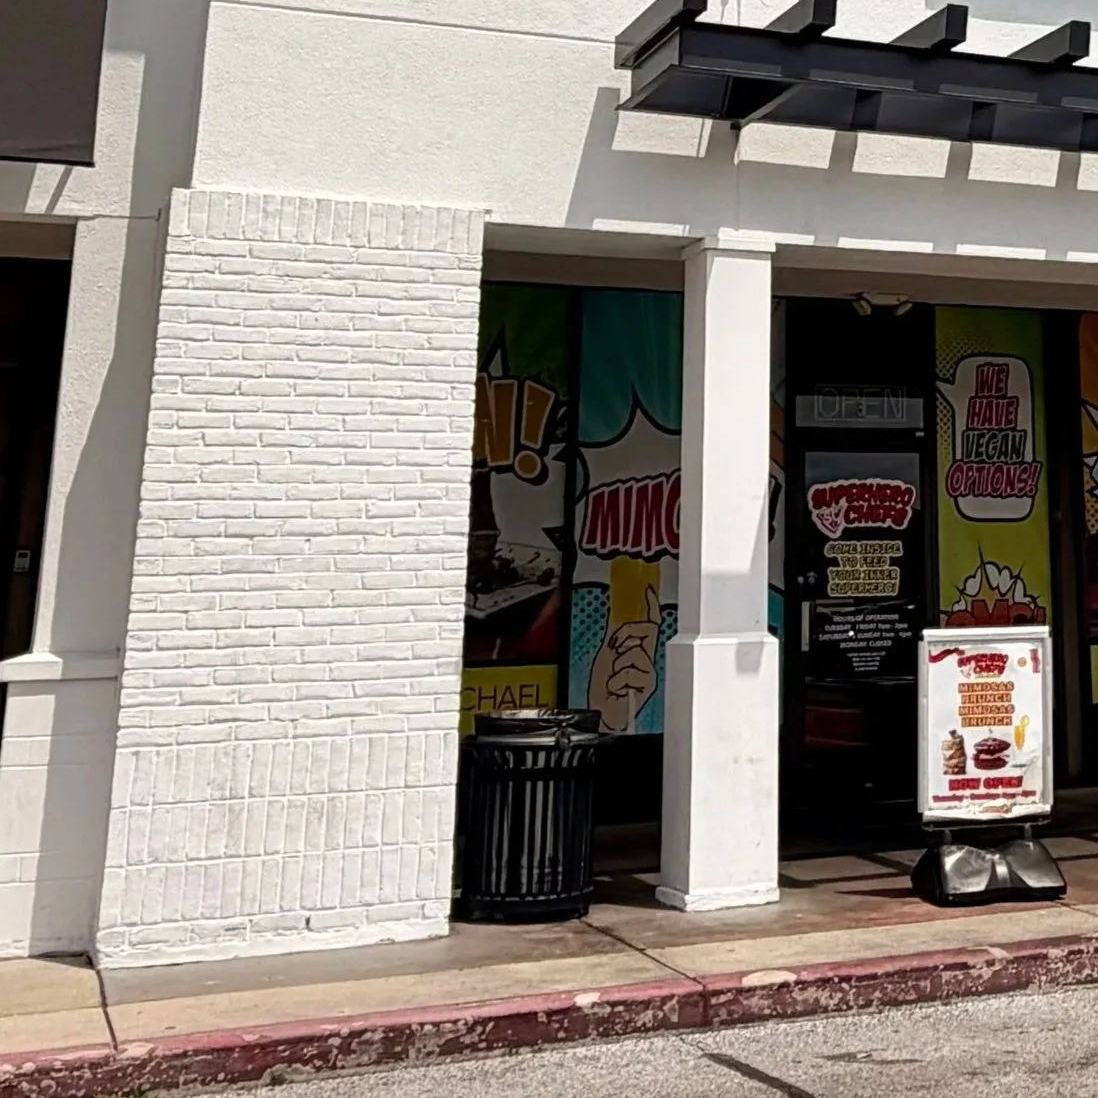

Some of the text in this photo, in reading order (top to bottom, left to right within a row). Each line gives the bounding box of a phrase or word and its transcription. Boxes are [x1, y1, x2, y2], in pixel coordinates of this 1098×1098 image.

[975, 362, 1009, 397] WE
[818, 387, 904, 419] OPEN
[967, 397, 1019, 429] HAVE
[962, 429, 1027, 463] VEGAN
[948, 461, 1041, 499] OPTIONS!
[958, 682, 1015, 693] MIMOSAS
[961, 693, 1012, 704] BRUNCH
[958, 704, 1015, 716] MIMOSAS
[961, 716, 1013, 727] BRUNCH
